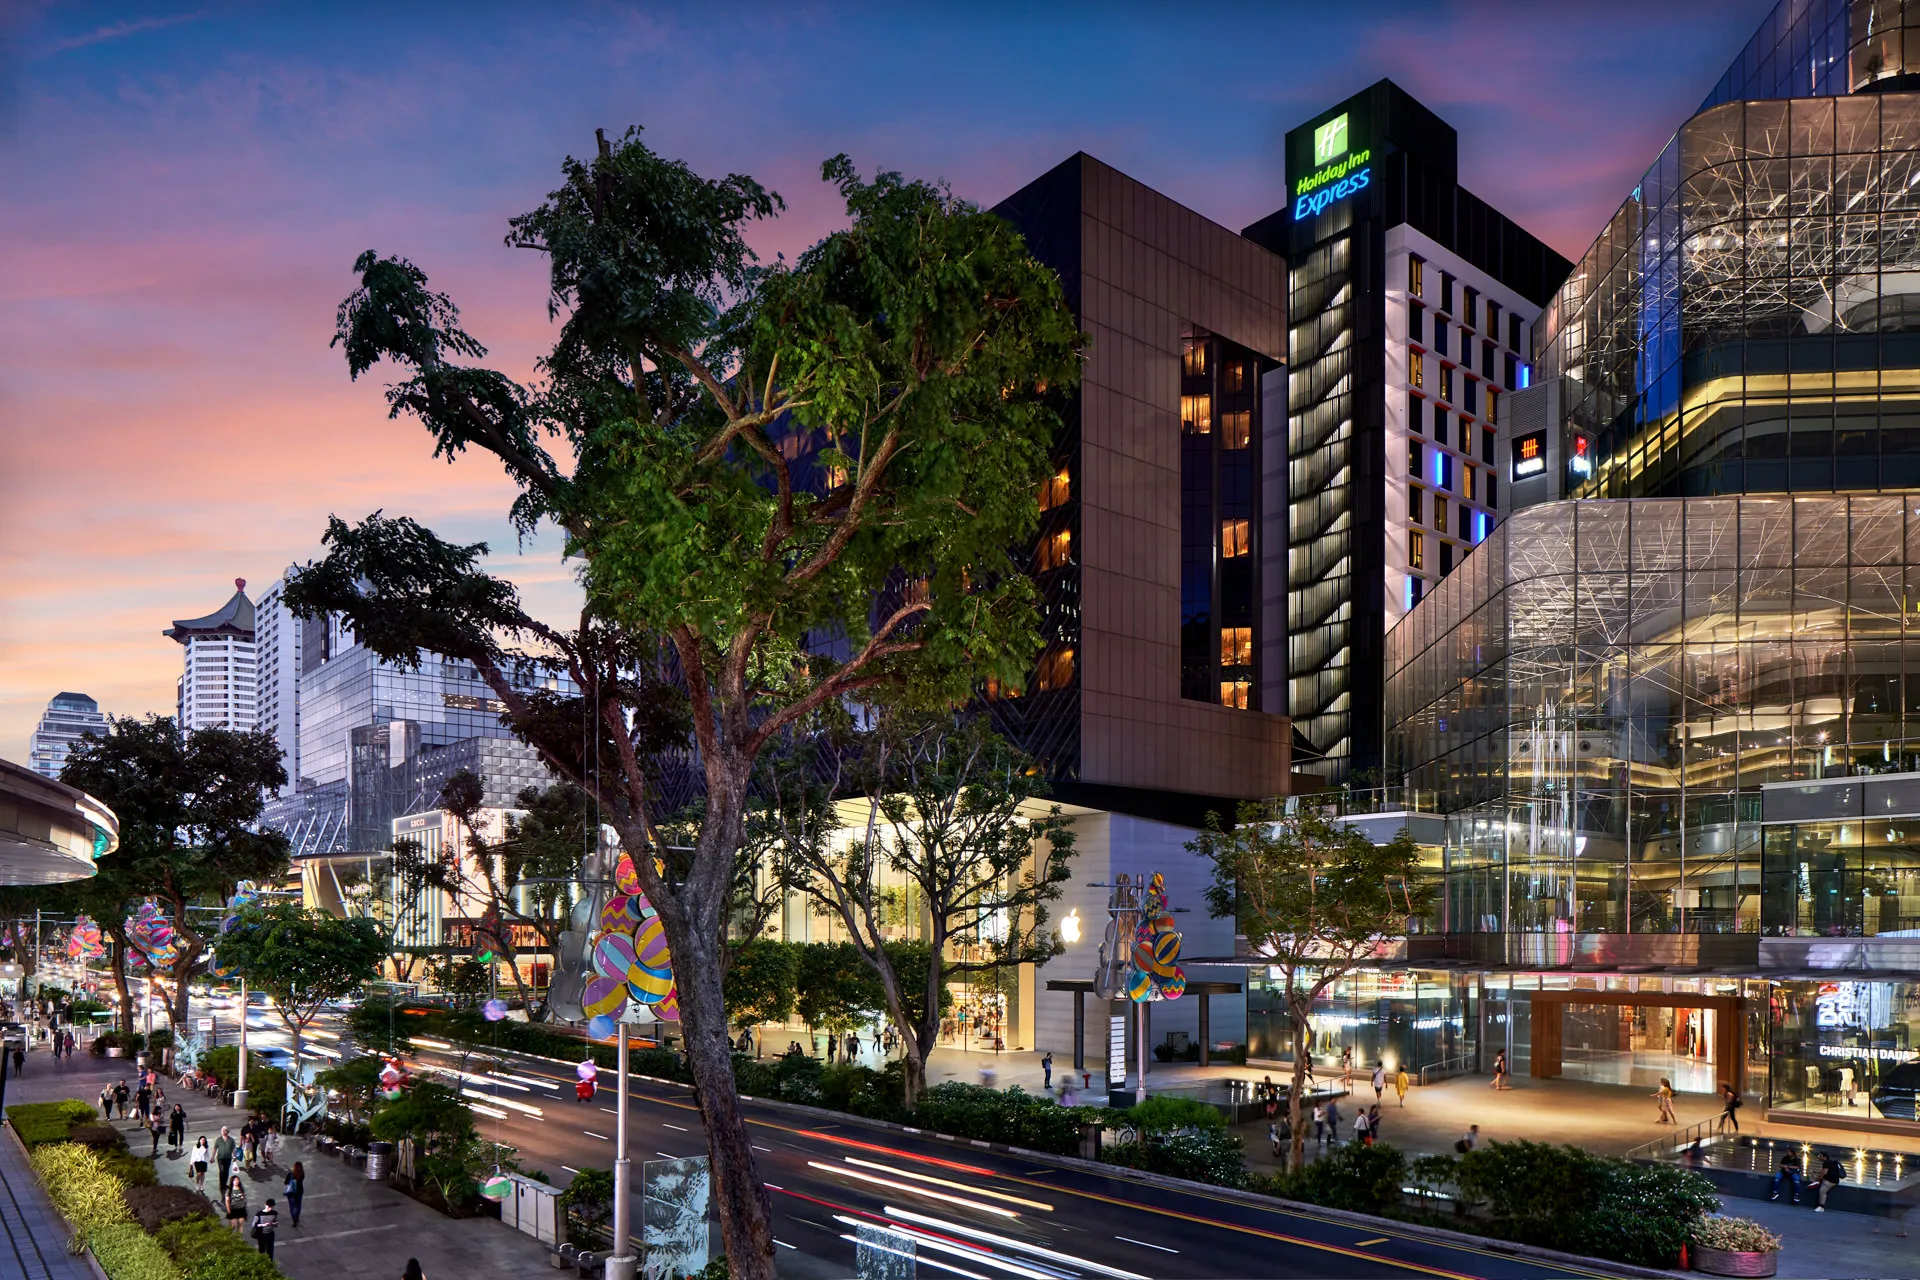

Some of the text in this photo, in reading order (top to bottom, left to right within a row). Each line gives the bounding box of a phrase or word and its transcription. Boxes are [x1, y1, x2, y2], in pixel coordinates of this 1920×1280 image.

[1297, 149, 1370, 195] Holiday Inn
[1294, 168, 1370, 220] Express
[411, 818, 425, 828] GUCCI
[1820, 1045, 1911, 1061] CHRISTIAN DADA
